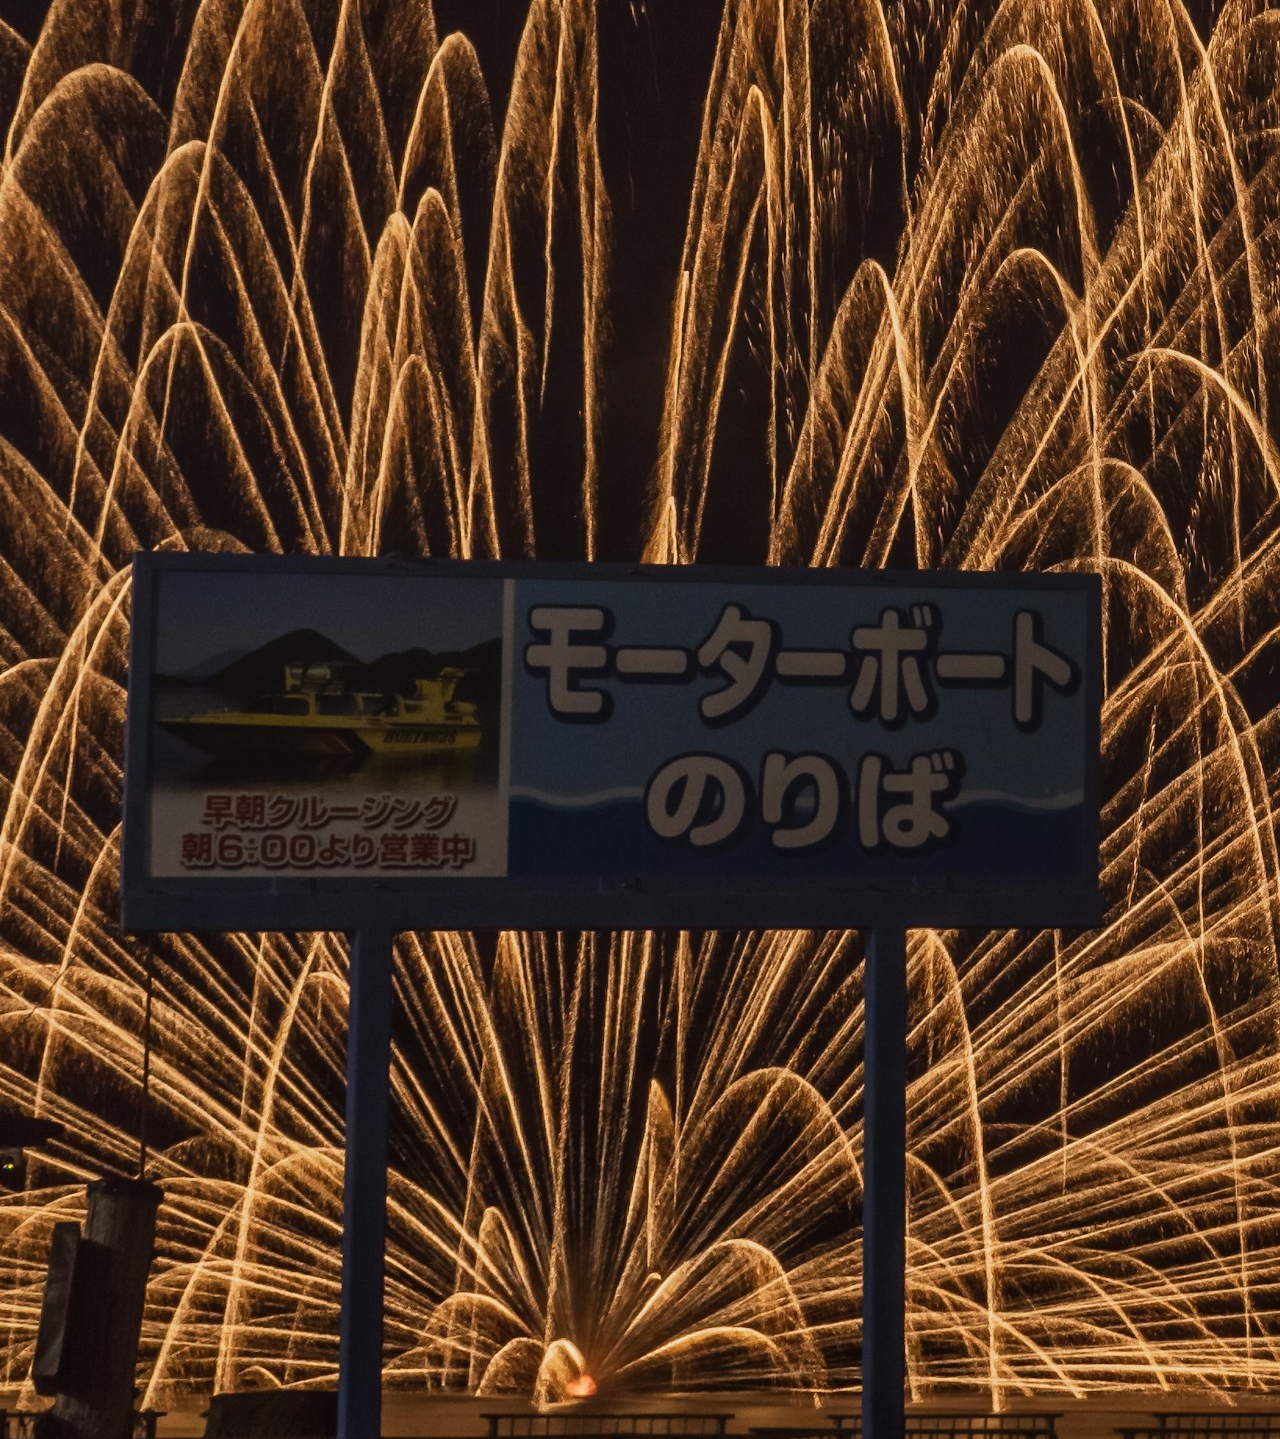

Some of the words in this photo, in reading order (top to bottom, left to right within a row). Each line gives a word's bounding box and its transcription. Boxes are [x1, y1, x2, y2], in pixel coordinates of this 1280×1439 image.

[524, 602, 1073, 723] モーターボート
[203, 794, 457, 829] 早朝クルージング
[646, 750, 956, 849] のりば
